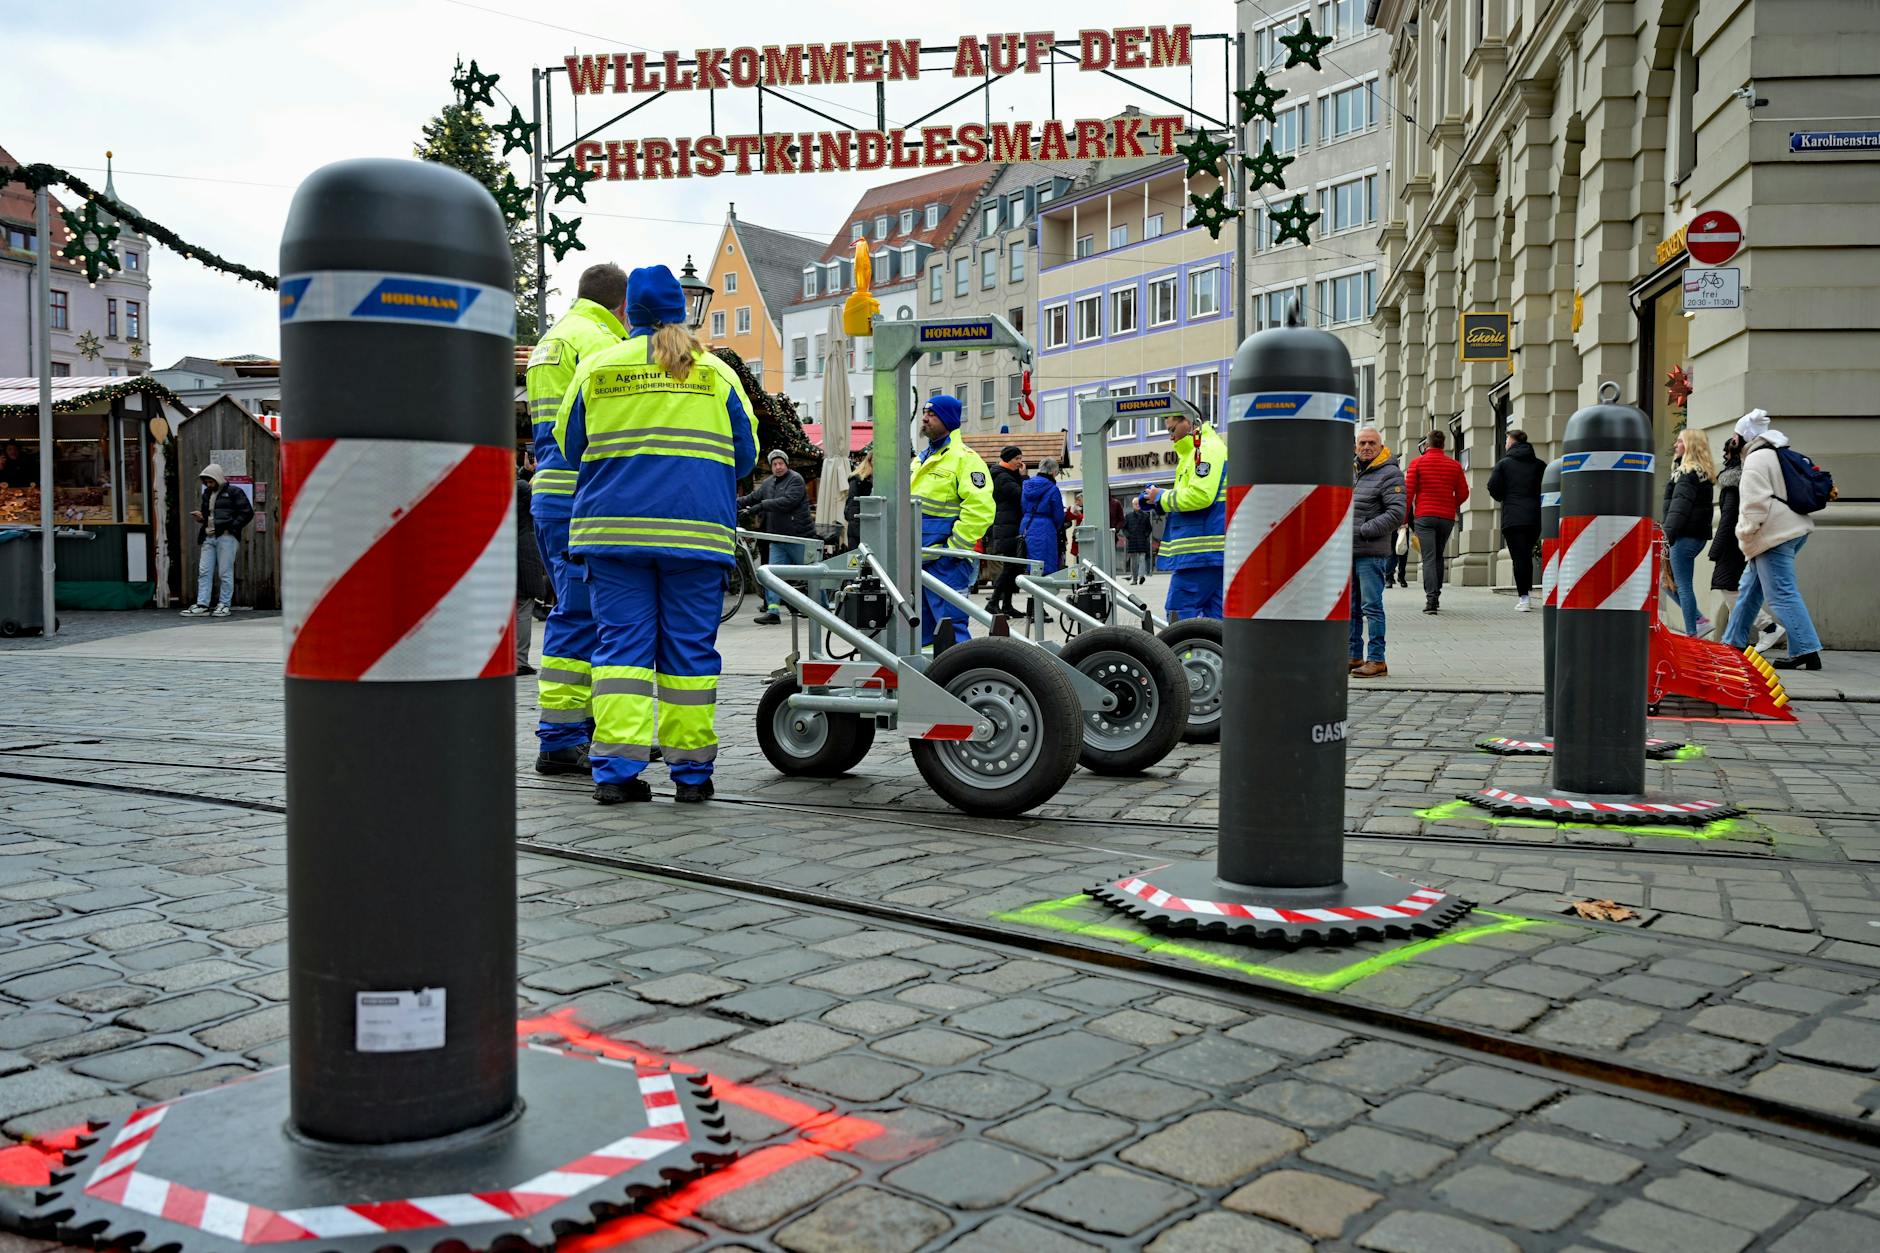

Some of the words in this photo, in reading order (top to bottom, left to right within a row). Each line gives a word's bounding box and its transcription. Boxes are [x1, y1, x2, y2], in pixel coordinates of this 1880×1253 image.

[564, 39, 921, 95] WILLKOMMEN
[952, 31, 1054, 78] AUF
[1079, 24, 1192, 71] DEM
[574, 115, 1185, 181] CHRISTKINDLESMARKT
[1801, 134, 1880, 147] Karolinenstra
[1466, 327, 1506, 343] Eckerle
[615, 371, 662, 383] Agentur
